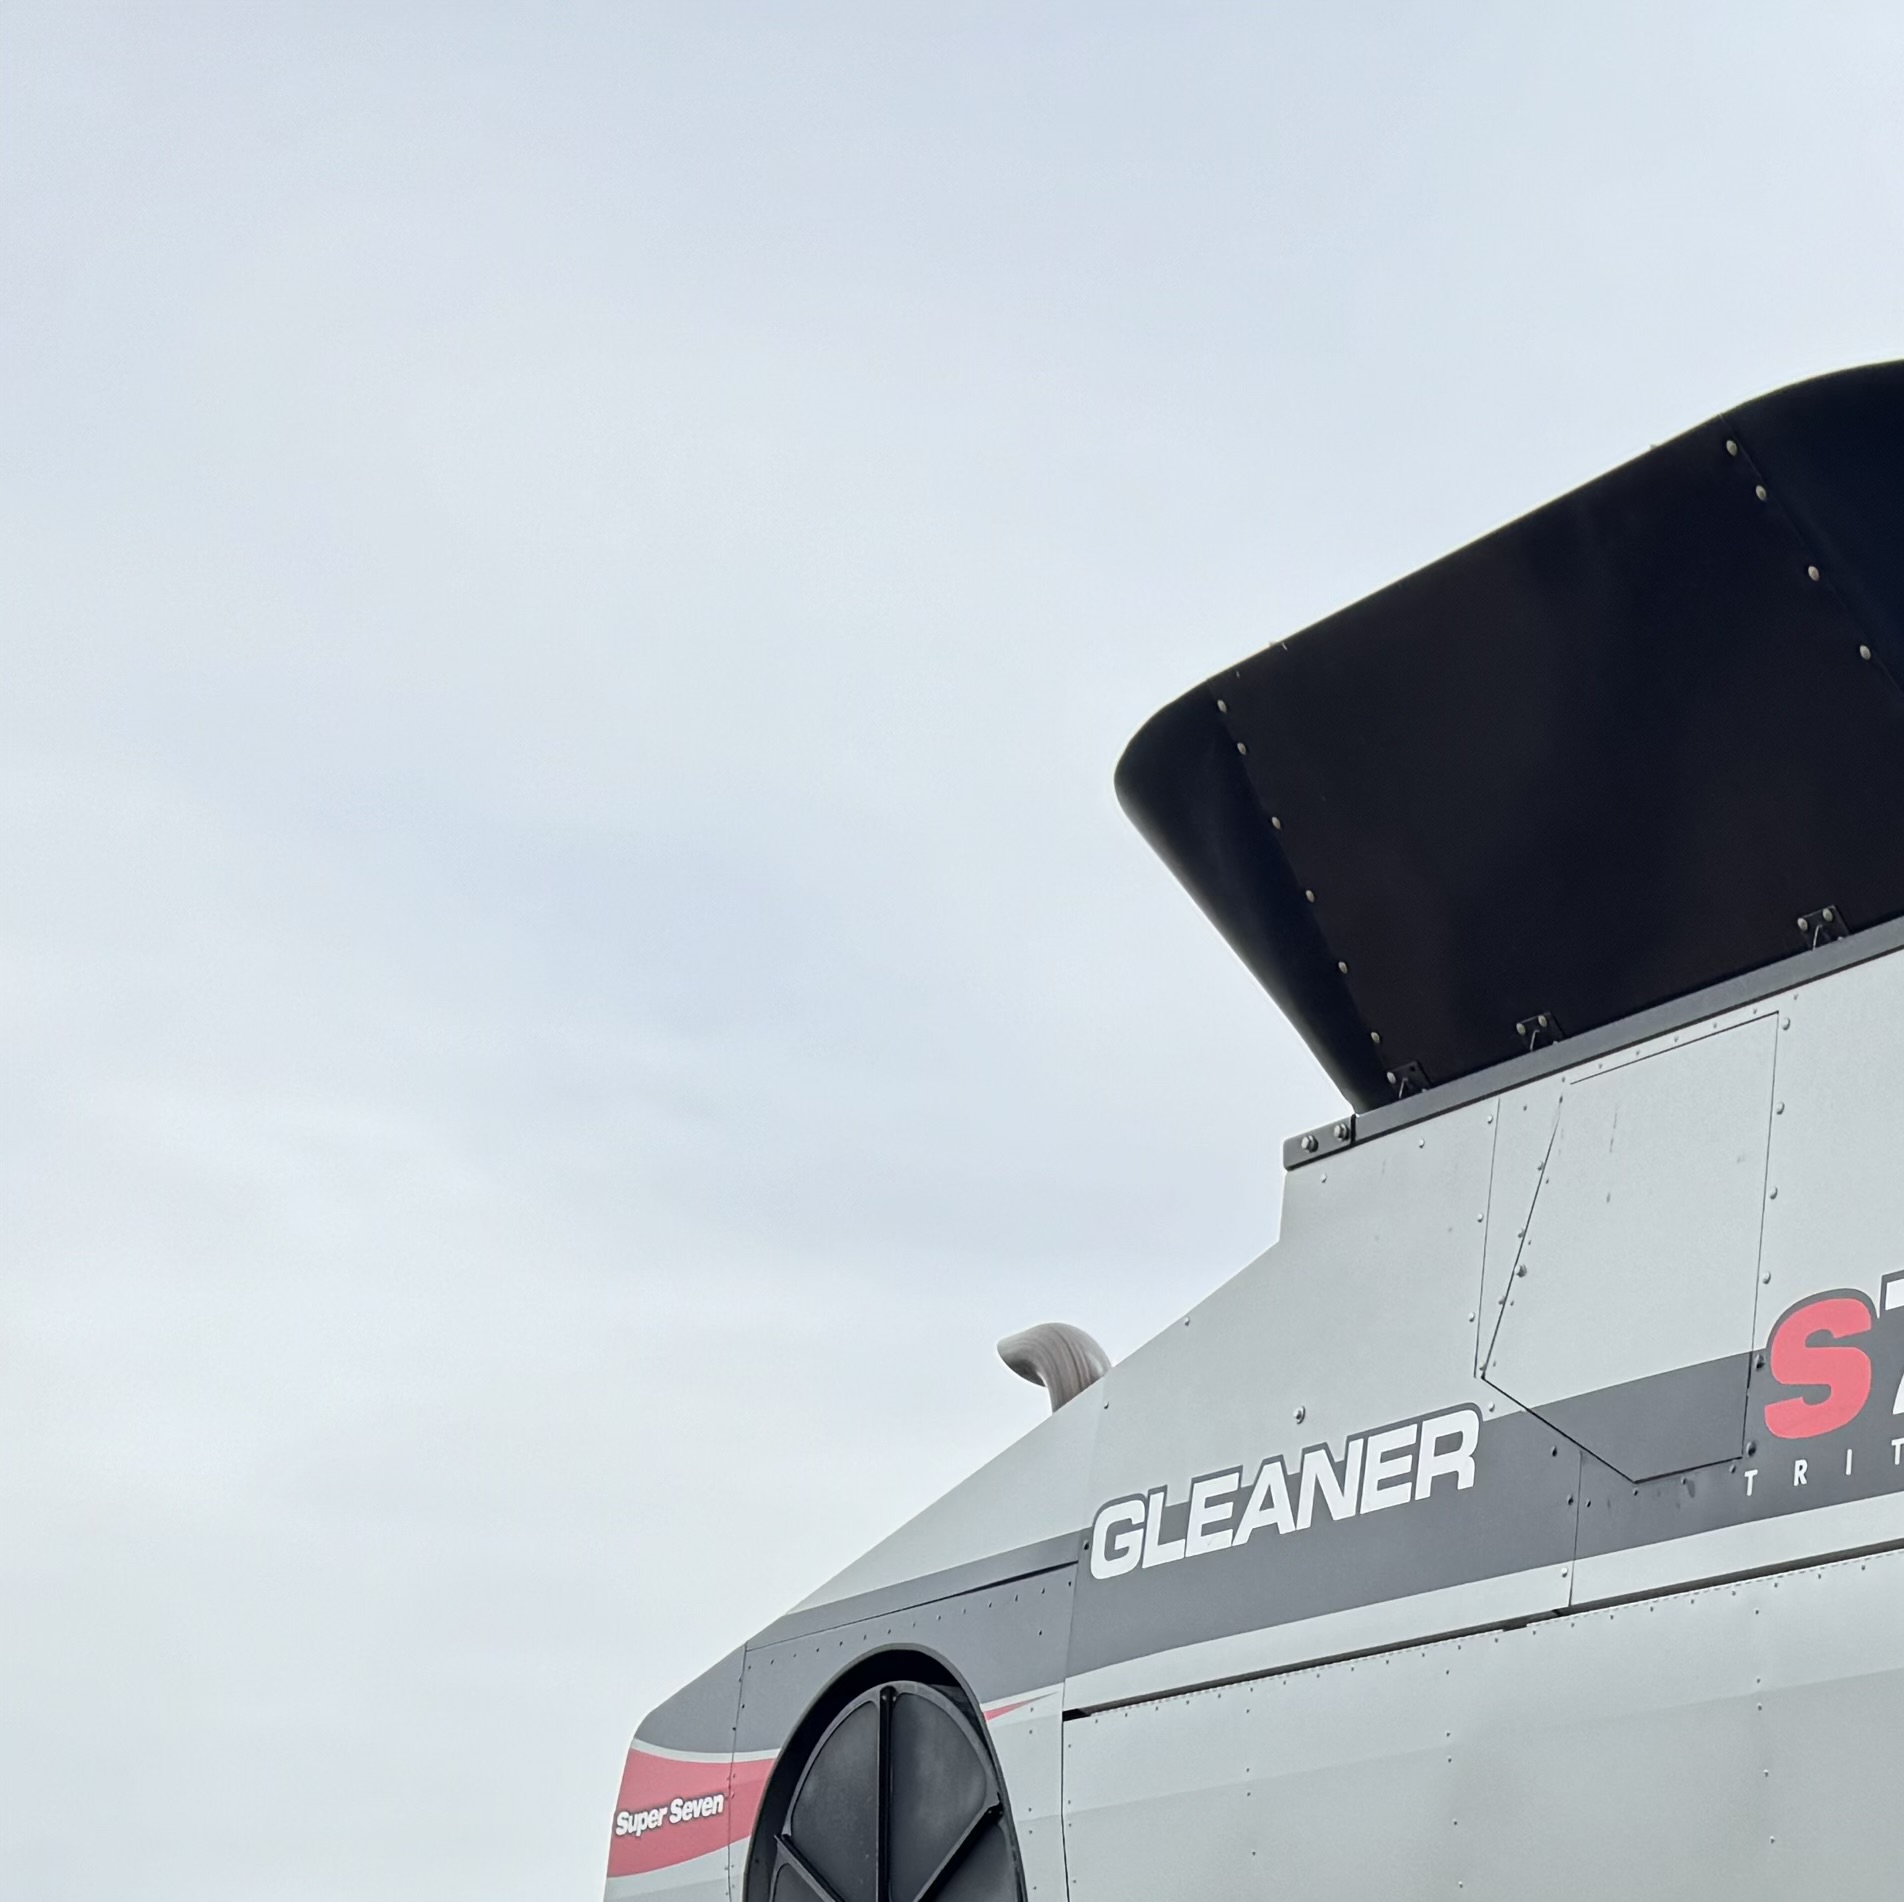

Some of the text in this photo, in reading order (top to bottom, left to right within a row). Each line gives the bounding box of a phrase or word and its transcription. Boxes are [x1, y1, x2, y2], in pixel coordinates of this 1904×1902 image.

[1090, 1408, 1480, 1580] GLEANER
[616, 1791, 723, 1838] Super Seven
